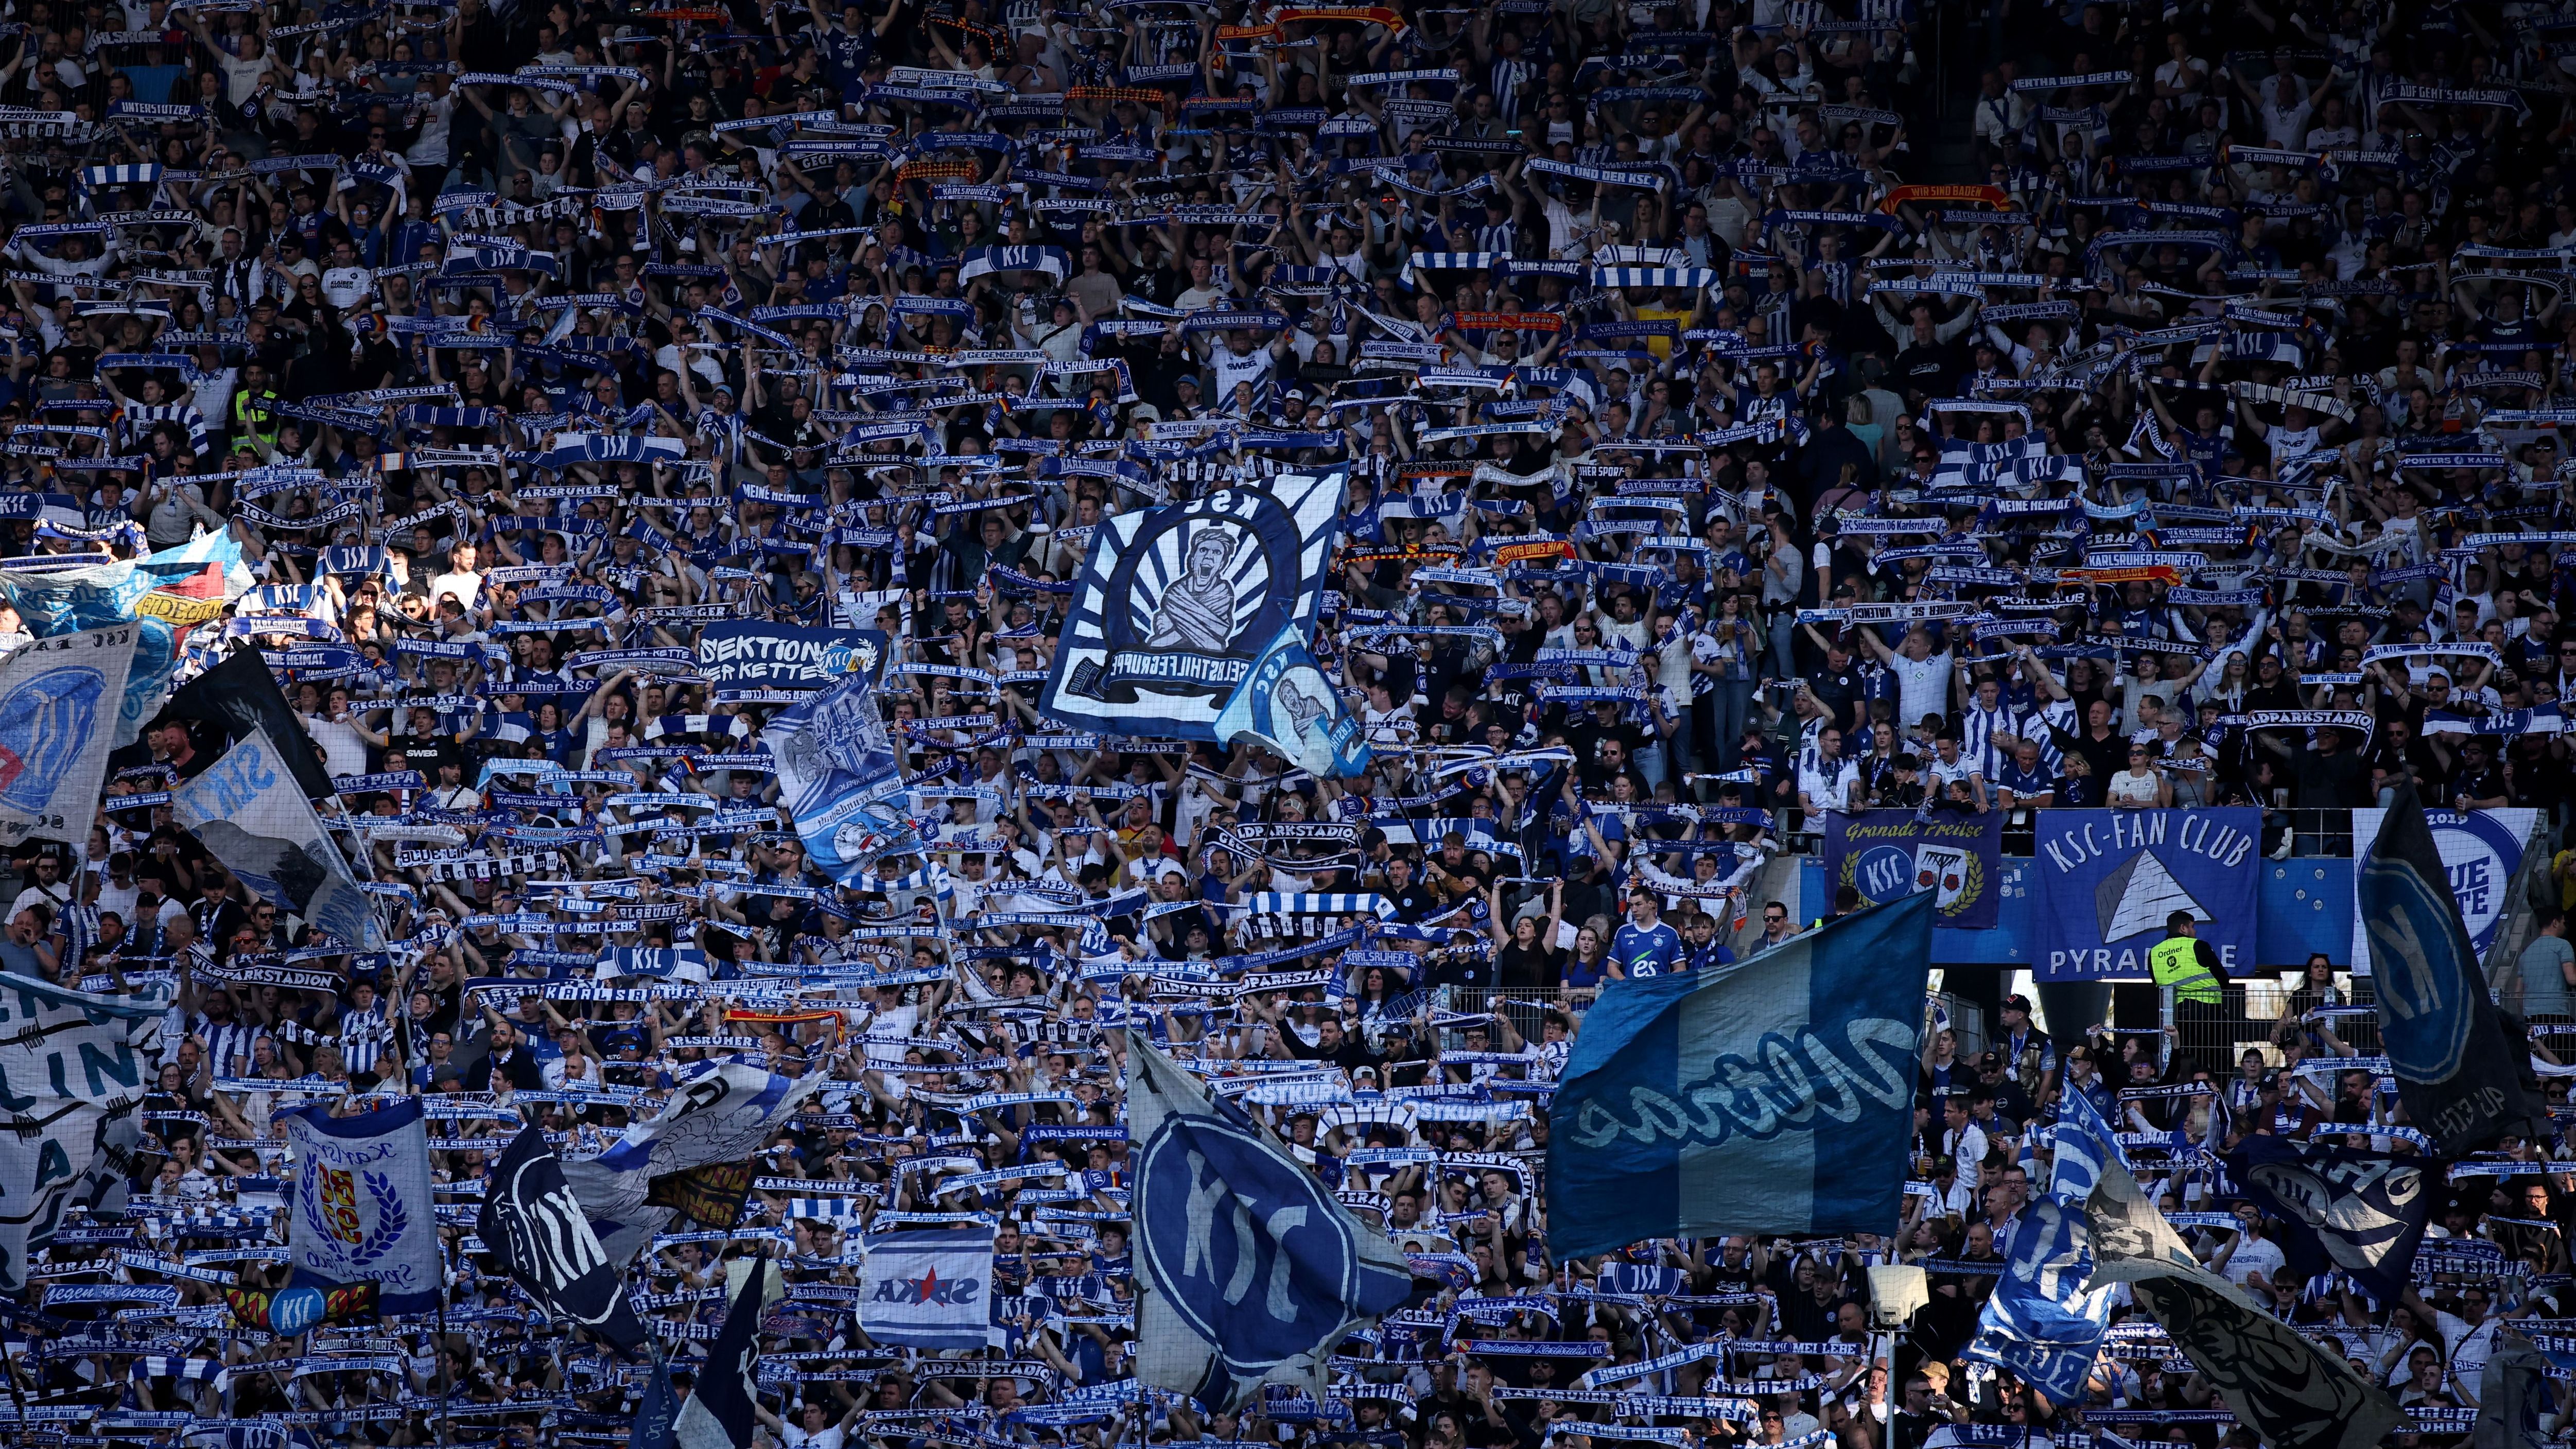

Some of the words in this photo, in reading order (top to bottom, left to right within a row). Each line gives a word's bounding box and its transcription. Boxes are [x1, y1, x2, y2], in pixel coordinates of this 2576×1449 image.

[2400, 86, 2417, 98] AUF
[1575, 166, 1597, 179] UND
[1602, 171, 1626, 183] DER
[1911, 187, 1927, 196] WIR
[1930, 186, 1950, 196] SIND
[1952, 186, 1982, 197] BADEN
[1003, 246, 1029, 266] KSC
[9, 270, 99, 287] KARLSRUHER
[104, 279, 121, 289] SC
[2236, 306, 2282, 321] KARLSRUHER
[390, 322, 452, 330] KARLSRUHER
[1186, 316, 1264, 326] KARLSRUHER
[1267, 317, 1282, 325] SC
[1364, 344, 1422, 354] KARLSRUHER
[1426, 346, 1437, 355] SC
[2236, 332, 2264, 355] KSC
[843, 346, 926, 362] KARLSRUHER
[1721, 346, 1783, 355] KARLSRUHER
[858, 423, 908, 435] KARLSRUHER
[911, 424, 922, 434] SC
[32, 446, 61, 455] LEBE
[1193, 442, 1217, 452] SPORT-CLUB
[1986, 443, 2013, 461] KSC
[2029, 458, 2053, 478] KSC
[1618, 480, 1676, 492] Karlsruher
[1424, 496, 1450, 514] KSC
[1592, 520, 1657, 533] KARLSRUHER
[1845, 520, 1852, 530] FC
[1854, 519, 1884, 531] Südstern
[1887, 519, 1894, 529] 06
[1897, 519, 1929, 531] Karlsruhe
[2090, 554, 2153, 566] KARLSRUHER
[1934, 568, 2013, 582] BERLIN
[274, 585, 300, 604] KSC
[250, 620, 307, 633] KARLSRUHER
[1977, 622, 2041, 635] Karlsruher
[700, 635, 820, 662] SEKTION
[2085, 635, 2198, 654] KARLSRUHE
[827, 649, 850, 667] KSC
[490, 682, 513, 692] Für
[520, 682, 560, 691] immer
[565, 680, 592, 691] KSC
[411, 697, 464, 705] GERADE
[1504, 693, 1519, 706] KSC
[929, 715, 993, 729] SPORT-CLUB
[406, 749, 437, 758] SWEG
[612, 748, 671, 757] KARLSRUHER
[372, 774, 414, 784] PAPA
[497, 797, 564, 807] KARLSRUHER
[2426, 812, 2468, 825] 2019
[1845, 823, 1919, 839] Granade
[2044, 812, 2169, 874] KSC-FAN
[2179, 813, 2254, 868] CLUB
[1866, 853, 1904, 895] KSC
[1643, 879, 1727, 896] KARLSRUHE
[500, 924, 514, 934] DU
[517, 923, 554, 932] BISCH
[576, 923, 601, 932] MEI
[603, 921, 636, 931] LEBE
[911, 927, 934, 936] DER
[1385, 927, 1398, 936] BSC
[2157, 945, 2183, 958] Ordner
[631, 948, 662, 969] KSC
[2050, 944, 2238, 975] PYRAE
[189, 954, 333, 987] WILDPARKSTADION
[1633, 959, 1657, 977] es
[869, 978, 893, 987] GEGEN
[896, 976, 915, 985] ALLE
[1445, 1083, 1475, 1097] BSC
[1029, 1126, 1122, 1139] KARLSRUHER
[2128, 1131, 2173, 1145] HEIMAT.
[1350, 1154, 1380, 1164] VEREINT
[1382, 1154, 1409, 1162] GEGEN
[1411, 1152, 1430, 1161] ALLE
[903, 1161, 917, 1172] FÜR
[920, 1158, 947, 1169] IMMER
[999, 1171, 1027, 1180] GEGEN
[1031, 1168, 1049, 1177] ALLE
[755, 1178, 856, 1193] KARLSRUHER
[860, 1184, 879, 1195] SC
[87, 1227, 127, 1238] BERLIN
[1181, 1148, 1310, 1323] KSC
[205, 1253, 235, 1262] VEREINT
[237, 1251, 265, 1260] GEGEN
[268, 1251, 289, 1260] ALLE
[41, 1260, 113, 1273] GERADE
[161, 1261, 188, 1273] UND
[191, 1267, 216, 1280] DER
[46, 1286, 96, 1302] gegen
[120, 1287, 176, 1301] gerade
[282, 1296, 315, 1325] KSC
[1002, 1297, 1031, 1318] KSC
[1656, 1352, 1685, 1368] UND
[1689, 1344, 1716, 1360] DER
[309, 1362, 339, 1371] VEREINT
[342, 1360, 370, 1369] GEGEN
[1972, 1424, 2006, 1440] KSC
